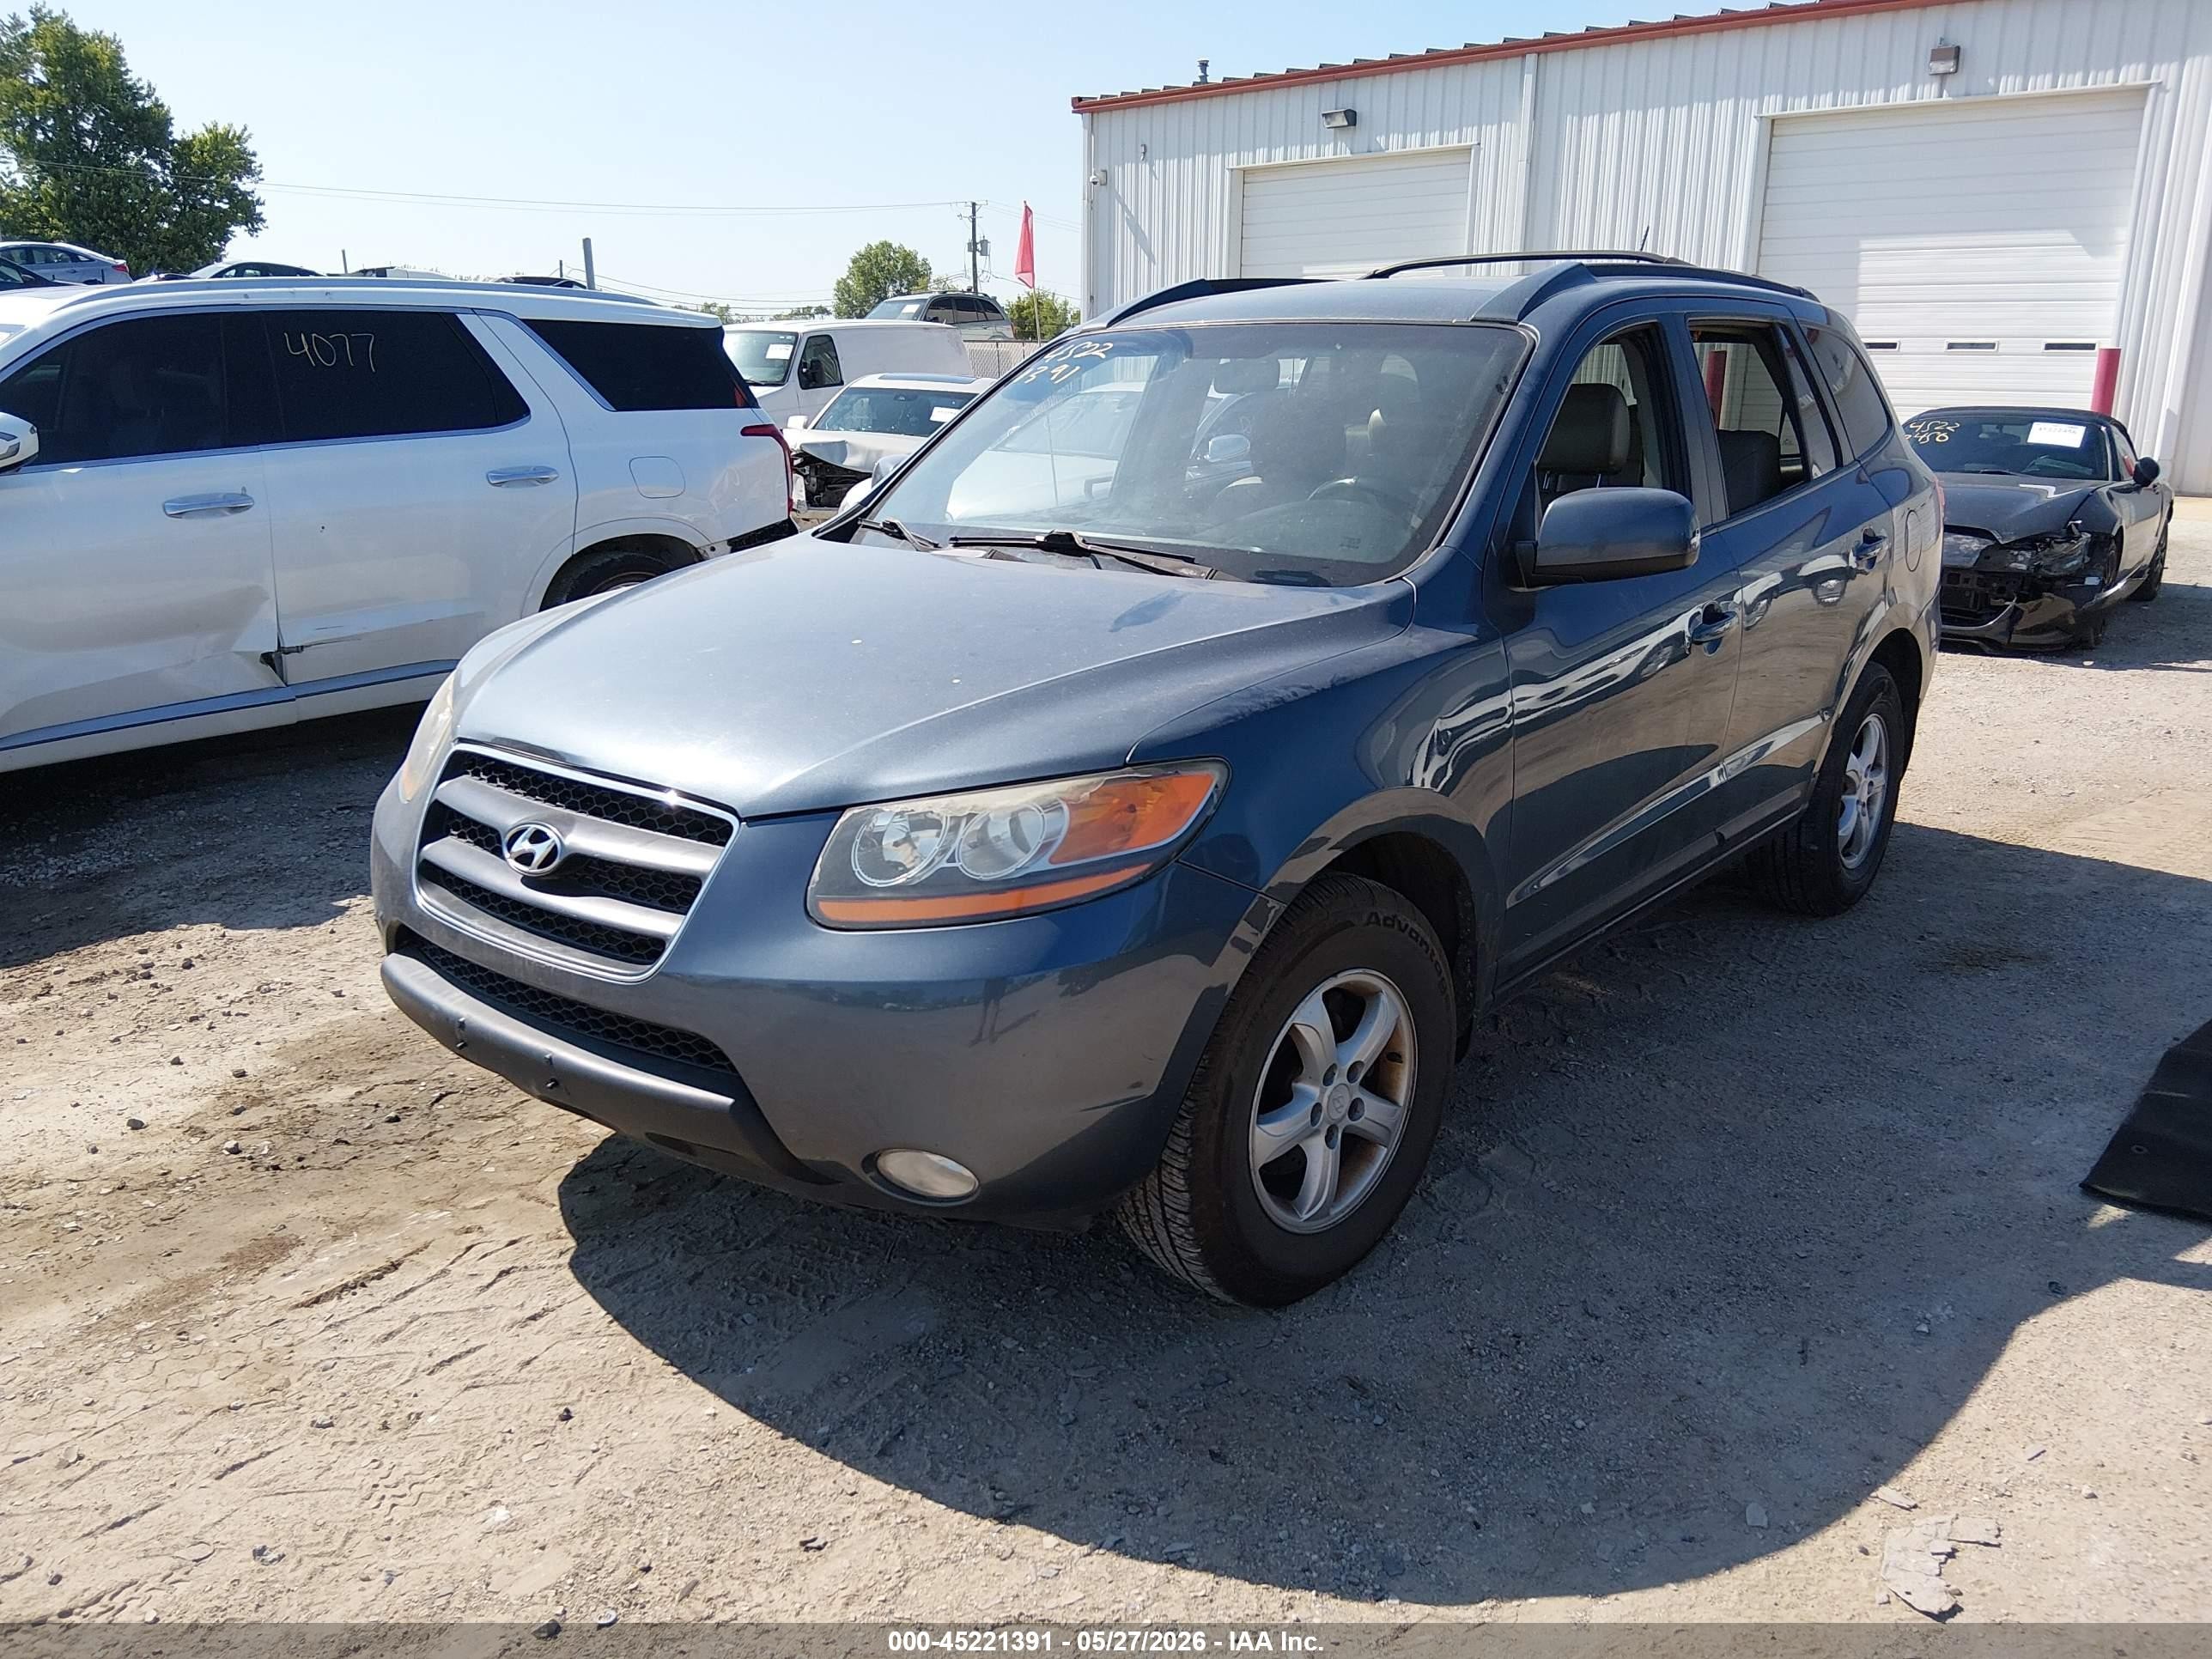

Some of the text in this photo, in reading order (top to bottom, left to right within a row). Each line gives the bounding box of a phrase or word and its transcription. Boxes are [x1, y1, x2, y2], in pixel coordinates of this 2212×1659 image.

[283, 332, 376, 373] 4077
[1043, 341, 1114, 362] 4522
[1909, 420, 1960, 433] 4522
